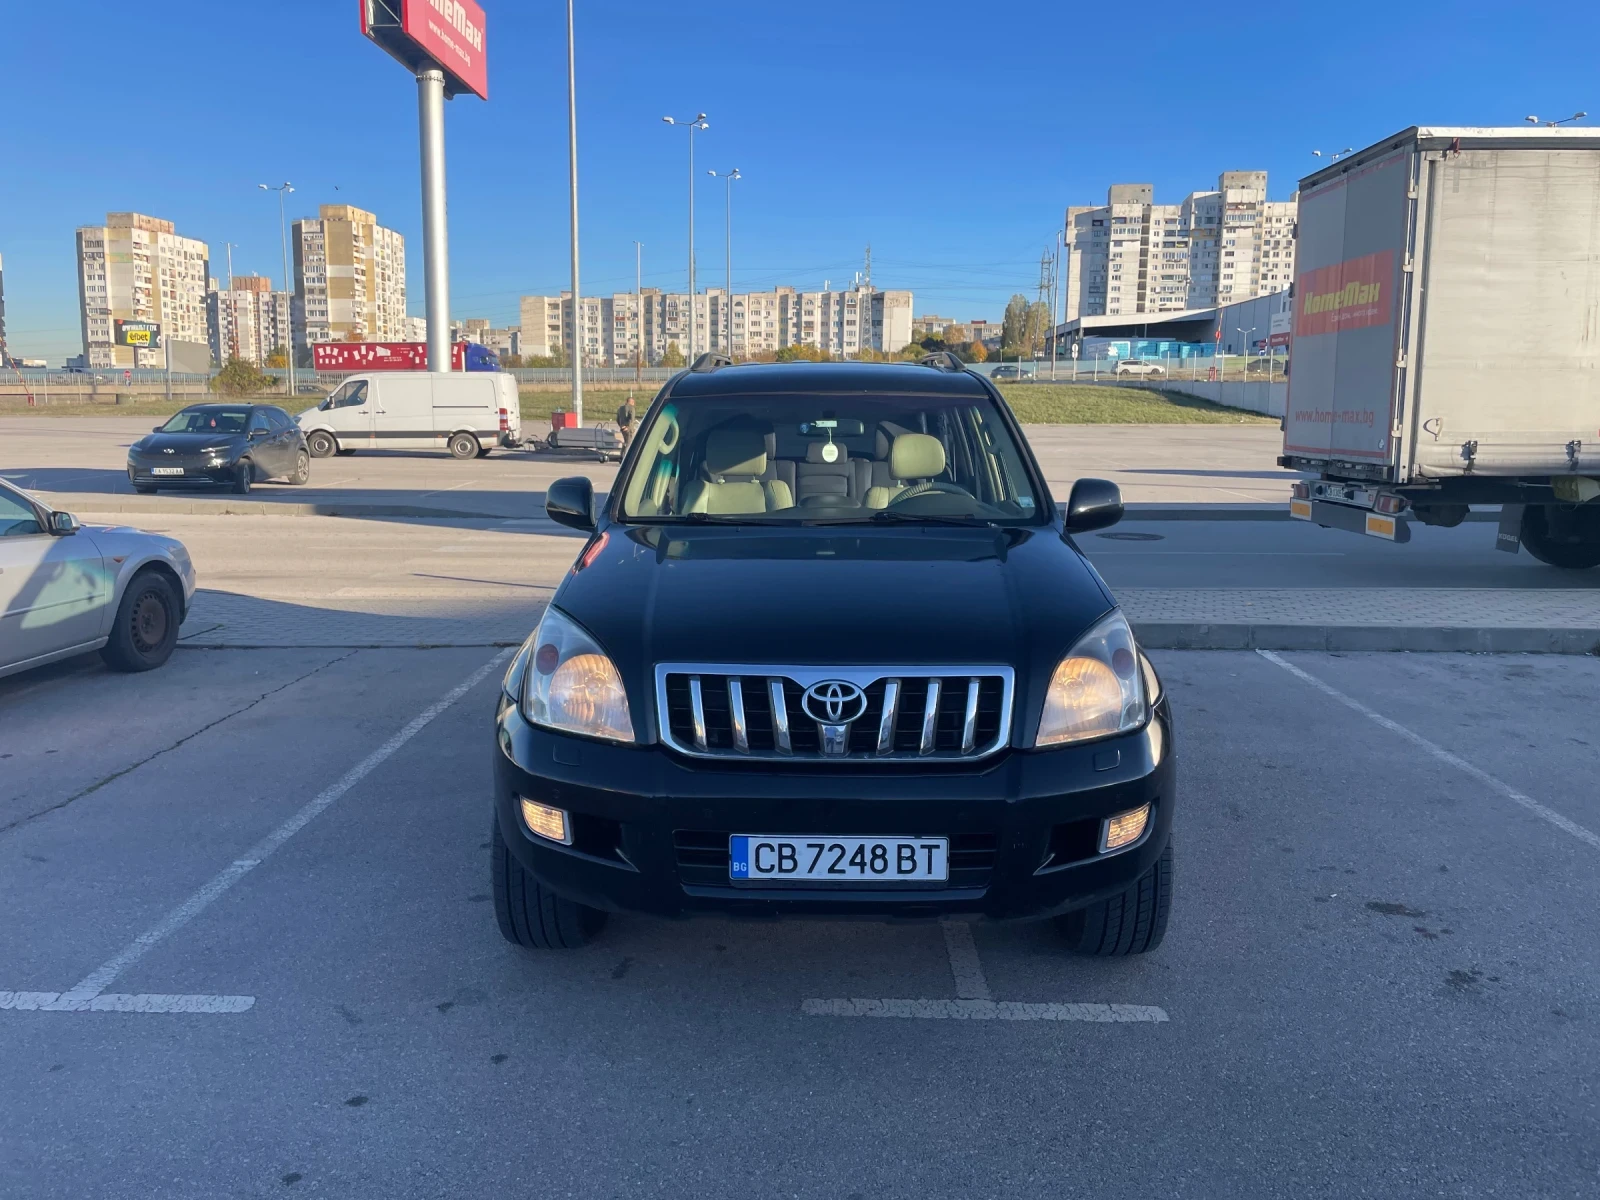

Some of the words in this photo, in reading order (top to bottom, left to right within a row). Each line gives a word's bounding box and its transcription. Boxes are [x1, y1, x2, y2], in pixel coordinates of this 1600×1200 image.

[427, 0, 482, 53] meMax
[1303, 281, 1381, 315] HomeMax
[129, 332, 148, 341] efbet
[1295, 406, 1375, 429] www.home-max.bg
[733, 862, 748, 872] BG
[754, 842, 799, 874] CB
[806, 843, 889, 875] 7248
[896, 843, 941, 875] BT
